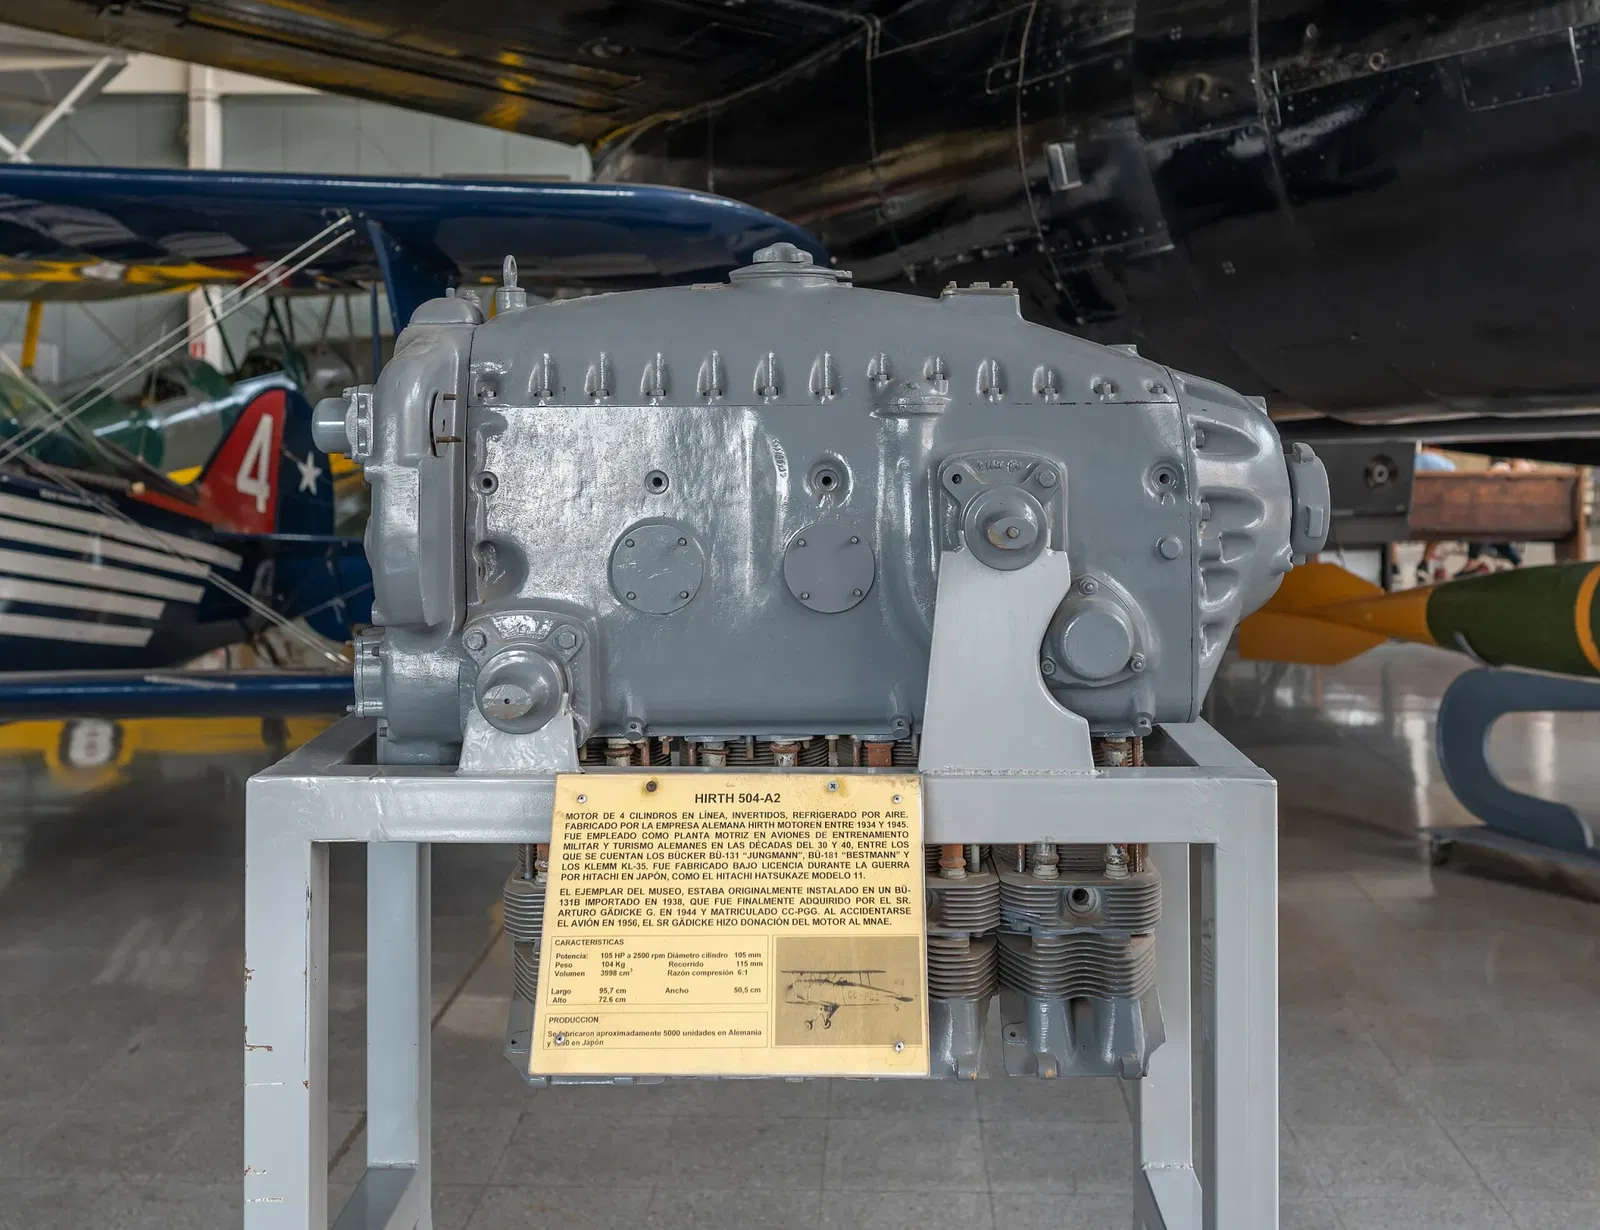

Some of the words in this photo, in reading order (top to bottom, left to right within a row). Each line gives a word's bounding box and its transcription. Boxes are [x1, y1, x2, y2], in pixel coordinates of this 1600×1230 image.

[236, 413, 273, 513] 4
[695, 792, 734, 805] HIRTH
[738, 791, 781, 805] 504-A2
[566, 812, 599, 821] MOTOR
[603, 812, 615, 821] DE
[619, 812, 625, 821] 4
[629, 812, 678, 820] CILINDROS
[682, 812, 694, 820] EN
[699, 810, 728, 821] LÍNEA,
[732, 811, 788, 821] INVERTIDOS,
[792, 811, 857, 819] REFRIGERADO
[861, 811, 881, 819] POR
[884, 811, 908, 819] AIRE.
[565, 822, 618, 830] FABRICADO
[620, 822, 640, 830] POR
[642, 822, 654, 830] LA
[656, 822, 700, 830] EMPRESA
[701, 822, 746, 830] ALEMANA
[748, 821, 775, 830] HIRTH
[777, 821, 822, 829] MOTOREN
[824, 821, 854, 829] ENTRE
[857, 821, 876, 829] 1934
[878, 821, 884, 829] Y
[887, 821, 908, 829] 1945.
[564, 832, 582, 840] FUE
[586, 832, 637, 840] EMPLEADO
[641, 832, 670, 840] COMO
[674, 832, 710, 840] PLANTA
[715, 831, 749, 840] MOTRIZ
[754, 831, 766, 840] EN
[770, 831, 810, 840] AVIONES
[815, 831, 827, 840] DE
[832, 831, 910, 839] ENTRENAMIENTO
[563, 842, 600, 850] MILITAR
[603, 842, 610, 850] Y
[613, 842, 654, 850] TURISMO
[657, 842, 708, 850] ALEMANES
[711, 842, 724, 850] EN
[727, 842, 745, 850] LAS
[749, 839, 793, 850] DÉCADAS
[796, 841, 814, 850] DEL
[818, 841, 828, 850] 30
[832, 841, 838, 850] Y
[841, 841, 854, 851] 40,
[857, 841, 888, 849] ENTRE
[891, 841, 910, 849] LOS
[562, 852, 582, 862] QUE
[584, 852, 597, 861] SE
[600, 852, 644, 861] CUENTAN
[646, 852, 665, 860] LOS
[668, 850, 706, 860] BÜCKER
[709, 850, 739, 860] BÜ-131
[808, 849, 838, 860] BÜ-181
[903, 851, 910, 859] Y
[562, 862, 580, 871] LOS
[584, 862, 617, 871] KLEMM
[621, 862, 649, 871] KL-35.
[652, 862, 671, 871] FUE
[675, 862, 729, 871] FABRICADO
[732, 862, 758, 870] BAJO
[762, 862, 804, 870] LICENCIA
[808, 862, 851, 870] DURANTE
[855, 861, 868, 870] LA
[871, 861, 910, 870] GUERRA
[560, 873, 581, 881] POR
[582, 872, 619, 881] HITACHI
[621, 872, 634, 881] EN
[636, 870, 670, 882] JAPÓN,
[672, 872, 700, 881] COMO
[702, 872, 714, 881] EL
[716, 872, 753, 881] HITACHI
[754, 872, 810, 880] HATSUKAZE
[812, 872, 851, 880] MODELO
[854, 872, 866, 880] 11.
[560, 888, 571, 896] EL
[574, 887, 624, 896] EJEMPLAR
[627, 887, 645, 896] DEL
[648, 887, 684, 897] MUSEO,
[688, 887, 725, 896] ESTABA
[728, 887, 803, 895] ORIGINALMENTE
[806, 887, 859, 895] INSTALADO
[862, 887, 875, 895] EN
[878, 887, 891, 895] UN
[894, 885, 911, 895] BÜ-
[560, 898, 581, 906] 131B
[585, 898, 640, 906] IMPORTADO
[644, 898, 658, 906] EN
[663, 898, 685, 907] 1938,
[690, 898, 710, 907] QUE
[714, 897, 733, 906] FUE
[737, 897, 795, 906] FINALMENTE
[799, 897, 851, 907] ADQUIRIDO
[856, 897, 876, 905] POR
[880, 897, 892, 905] EL
[896, 897, 911, 905] SR.
[558, 908, 597, 917] ARTURO
[600, 906, 642, 917] GÄDICKE
[646, 908, 656, 917] G.
[660, 908, 672, 917] EN
[677, 908, 697, 916] 1944
[700, 908, 707, 916] Y
[710, 908, 778, 916] MATRICULADO
[781, 907, 820, 916] CC-PGG.
[824, 907, 836, 915] AL
[840, 907, 911, 915] ACCIDENTARSE
[557, 919, 569, 928] EL
[570, 917, 600, 928] AVIÓN
[602, 919, 615, 927] EN
[618, 919, 640, 929] 1956,
[642, 919, 654, 927] EL
[656, 918, 669, 927] SR
[671, 916, 714, 927] GÄDICKE
[716, 918, 738, 927] HIZO
[740, 916, 790, 926] DONACIÓN
[792, 918, 810, 926] DEL
[812, 918, 846, 926] MOTOR
[848, 917, 861, 926] AL
[863, 917, 892, 926] MNAE.
[554, 938, 624, 946] CARACTERISTICAS
[556, 952, 589, 960] Potencia:
[601, 952, 613, 960] 105
[633, 952, 650, 960] 2500
[651, 953, 666, 961] rpm
[667, 951, 700, 960] Diámetro
[701, 951, 728, 959] cilindro
[734, 951, 747, 959] 105
[555, 961, 573, 969] Peso
[602, 960, 614, 969] 104
[668, 960, 704, 968] Recorrido
[736, 960, 749, 968] 115
[554, 970, 586, 978] Volumen
[600, 969, 618, 977] 3998
[667, 969, 690, 977] Razón
[691, 969, 734, 977] compresión
[737, 968, 748, 977] 6:1
[550, 987, 572, 997] Largo
[599, 987, 614, 997] 95,7
[665, 986, 690, 995] Ancho
[734, 986, 749, 996] 50,5
[552, 996, 567, 1004] Alto
[548, 1016, 599, 1024] PRODUCCION
[548, 1030, 556, 1038] Se
[596, 1030, 662, 1038] aproximadamente
[663, 1029, 681, 1038] 5000
[682, 1029, 716, 1038] unidades
[728, 1029, 762, 1038] Alemania
[582, 1039, 604, 1047] Japón
